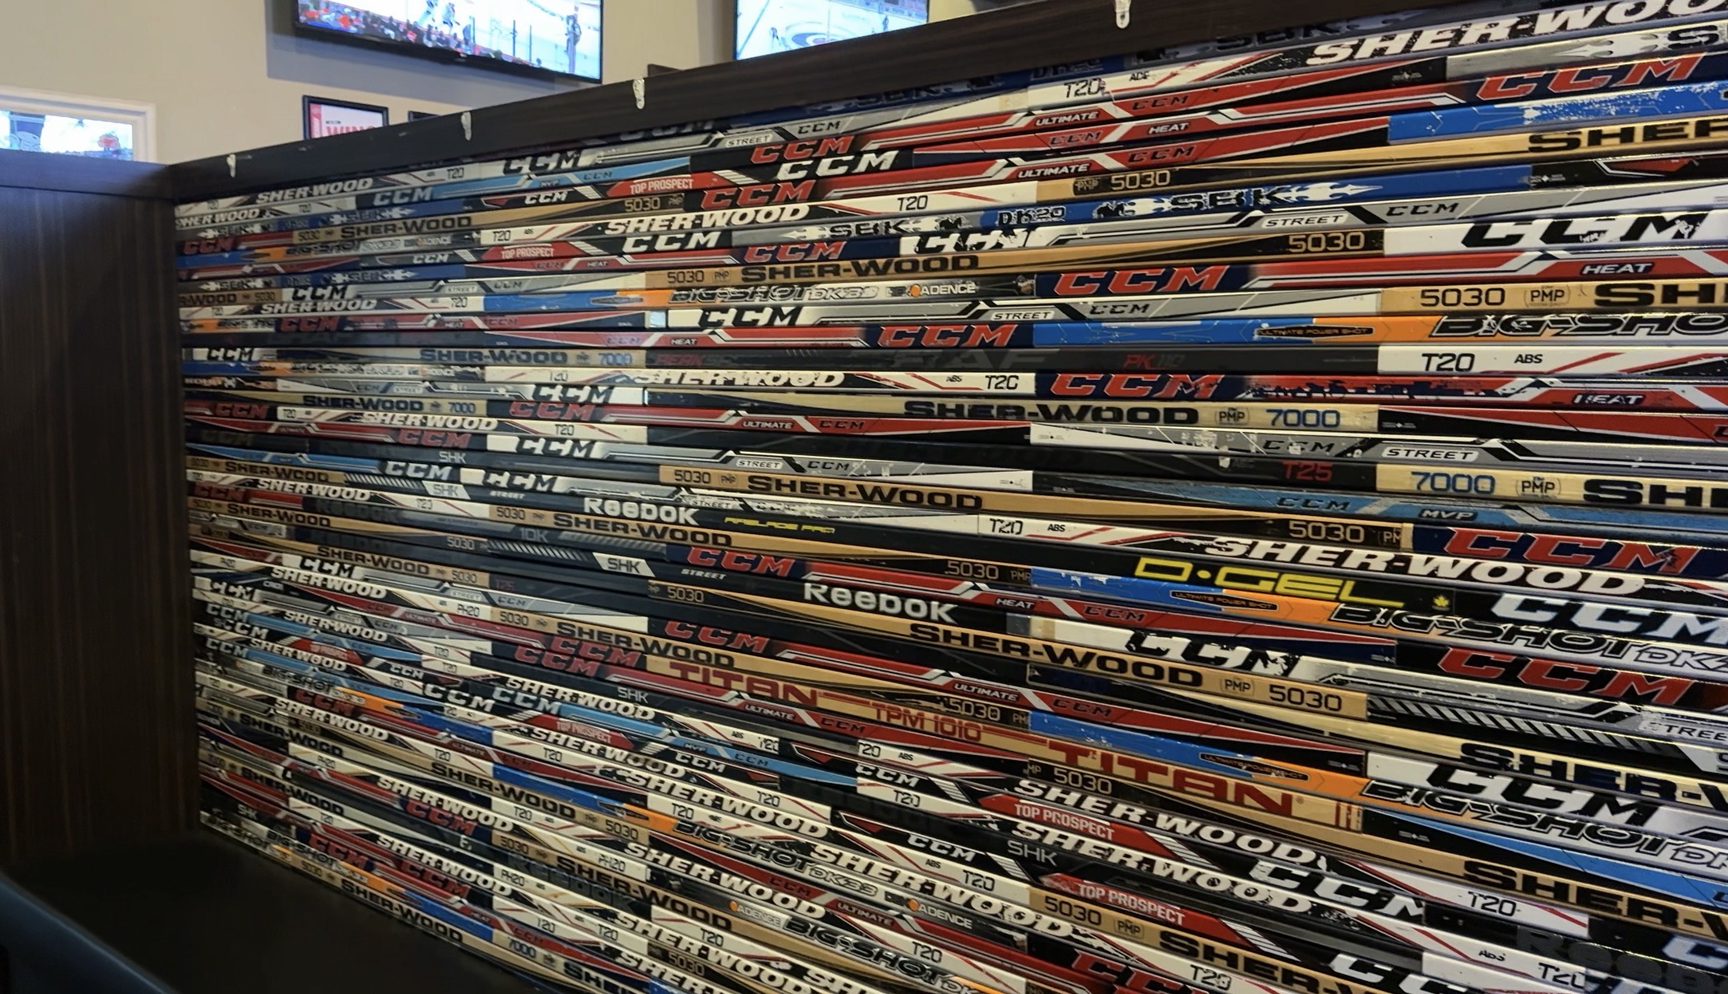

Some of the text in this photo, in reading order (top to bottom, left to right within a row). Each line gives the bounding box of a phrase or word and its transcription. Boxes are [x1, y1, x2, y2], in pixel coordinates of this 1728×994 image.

[1476, 52, 1707, 100] CCM
[1035, 96, 1188, 126] ULTIMATE CCM
[726, 121, 841, 146] STREET CCM
[1050, 122, 1188, 145] CCM HEAT
[750, 135, 854, 165] CCM
[1017, 146, 1195, 178] ULTIMATE CCM
[776, 150, 898, 180] CCM
[257, 177, 373, 205] SHER-WOOD
[630, 177, 693, 195] TOP PROSPECT
[1110, 170, 1170, 190] 5030
[373, 186, 433, 206] CCM
[524, 190, 568, 204] CCM
[624, 198, 661, 212] 5030
[701, 178, 816, 210] CCM
[605, 194, 928, 235] SHER-WOOD T20
[1265, 202, 1458, 227] STREET CCM
[341, 215, 471, 240] SHER-WOOD
[492, 229, 512, 243] T20
[1461, 212, 1709, 248] CCM
[515, 246, 554, 258] PROSPECT
[622, 231, 722, 254] CCM
[744, 241, 847, 264] CCM
[1288, 231, 1366, 252] 5030
[413, 252, 449, 264] CCM
[667, 254, 979, 284] 5030 SHER-WOOD
[1053, 263, 1654, 296] CCM HEAT
[1420, 288, 1565, 307] 5030 PMP
[699, 306, 799, 327] CCM
[994, 303, 1149, 320] STREET CCM
[671, 323, 1018, 348] HEAT CCM
[1421, 353, 1543, 373] T20 ABS
[533, 385, 613, 406] CCM
[1050, 373, 1643, 405] CCM HEAT
[449, 402, 477, 414] 7000
[508, 401, 864, 430] CCM ULTIMATE CCM
[904, 400, 1340, 427] SHER-WOOD PMP 7000
[398, 429, 471, 448] CCM
[555, 424, 574, 436] T20
[440, 451, 466, 464] SHK
[736, 459, 849, 471] STREET CCM
[1386, 448, 1473, 460] STREET
[387, 461, 452, 481] CCM
[1282, 460, 1333, 482] T25
[1411, 471, 1555, 494] 7000 PMP
[433, 483, 460, 498] SHK
[674, 469, 983, 510] 5030 SHER-WOOD
[228, 504, 331, 528] SHER-WOOD
[1276, 496, 1474, 519] CCM MVP
[497, 506, 526, 520] 5030
[553, 512, 733, 547] SHER-WOOD
[1288, 520, 1364, 543] 5030
[317, 546, 430, 576] SHER-WOOD
[687, 546, 796, 577] CCM
[1445, 527, 1700, 574] CCM
[607, 556, 727, 581] SHK STREET
[945, 560, 999, 580] 5030
[1205, 536, 1646, 594] SHER-WOOD
[667, 585, 705, 602] 5030
[457, 603, 480, 618] PH20
[997, 598, 1147, 622] HEAT CCM
[1491, 592, 1728, 645] CCM
[555, 620, 735, 668] SHER-WOOD
[664, 620, 771, 653] CCM
[550, 635, 641, 668] CCM
[908, 623, 1342, 712] SHER-WOOD PMP 5030
[1437, 646, 1693, 703] CCM
[514, 645, 794, 721] CCM ULTIMATE
[617, 687, 649, 703] SHK
[424, 682, 494, 713] CCM
[505, 677, 657, 721] SHER-WOOD
[954, 684, 1112, 716] ULTIMATE CCM
[275, 697, 389, 742] SHER-WOOD
[949, 701, 1000, 720] 5030
[669, 660, 816, 706] TITAN
[873, 701, 926, 728] TPM
[933, 717, 983, 743] 1010
[1048, 740, 1292, 817] TITAN
[529, 726, 686, 780] SHER-WOOD
[675, 750, 726, 773] CCM
[855, 763, 920, 788] CCM
[1054, 767, 1112, 795] 5030
[542, 748, 829, 839] T20 SHER-WOOD
[757, 790, 781, 808] T20
[1426, 762, 1658, 828] CCM
[673, 802, 695, 820] T20
[1014, 779, 1316, 864] SHER-WOOD
[1015, 803, 1115, 841] TOP PROSPECT
[605, 819, 640, 841] 5030
[907, 832, 976, 863] CCM
[1007, 839, 1057, 867] SHK
[598, 852, 627, 872] PH20
[1012, 821, 1312, 913] SHER-WOOD
[501, 868, 526, 887] PH20
[513, 807, 943, 963] T20 SHER-WOOD T20
[963, 869, 995, 893] T20
[556, 854, 733, 931] SHER-WOOD
[1079, 882, 1185, 926] TOP PROSPECT
[1468, 890, 1516, 917] T20
[837, 902, 893, 926] ULTIMATE
[1045, 896, 1103, 926] 5030
[508, 938, 538, 960] 7000
[702, 927, 725, 948] T20
